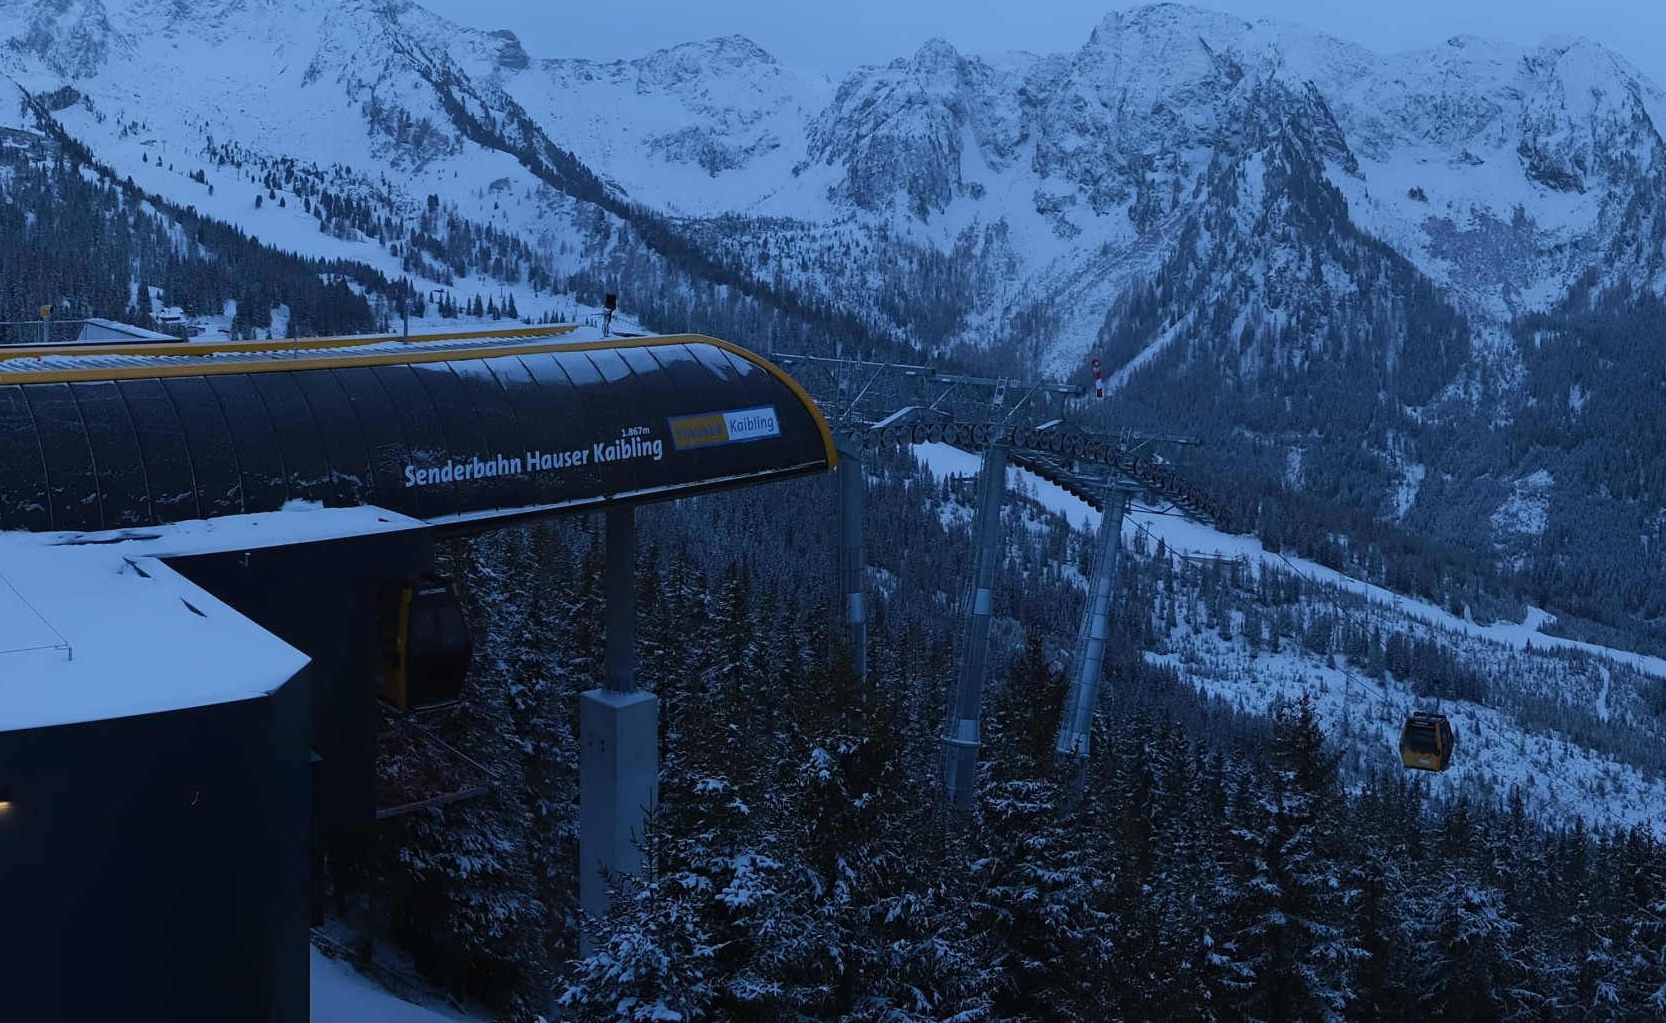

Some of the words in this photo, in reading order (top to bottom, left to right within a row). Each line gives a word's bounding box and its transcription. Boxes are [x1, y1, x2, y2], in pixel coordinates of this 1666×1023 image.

[729, 416, 774, 432] Kaibling
[404, 453, 521, 488] Senderbahn
[526, 447, 589, 471] Hauser
[593, 438, 663, 461] Kaibling
